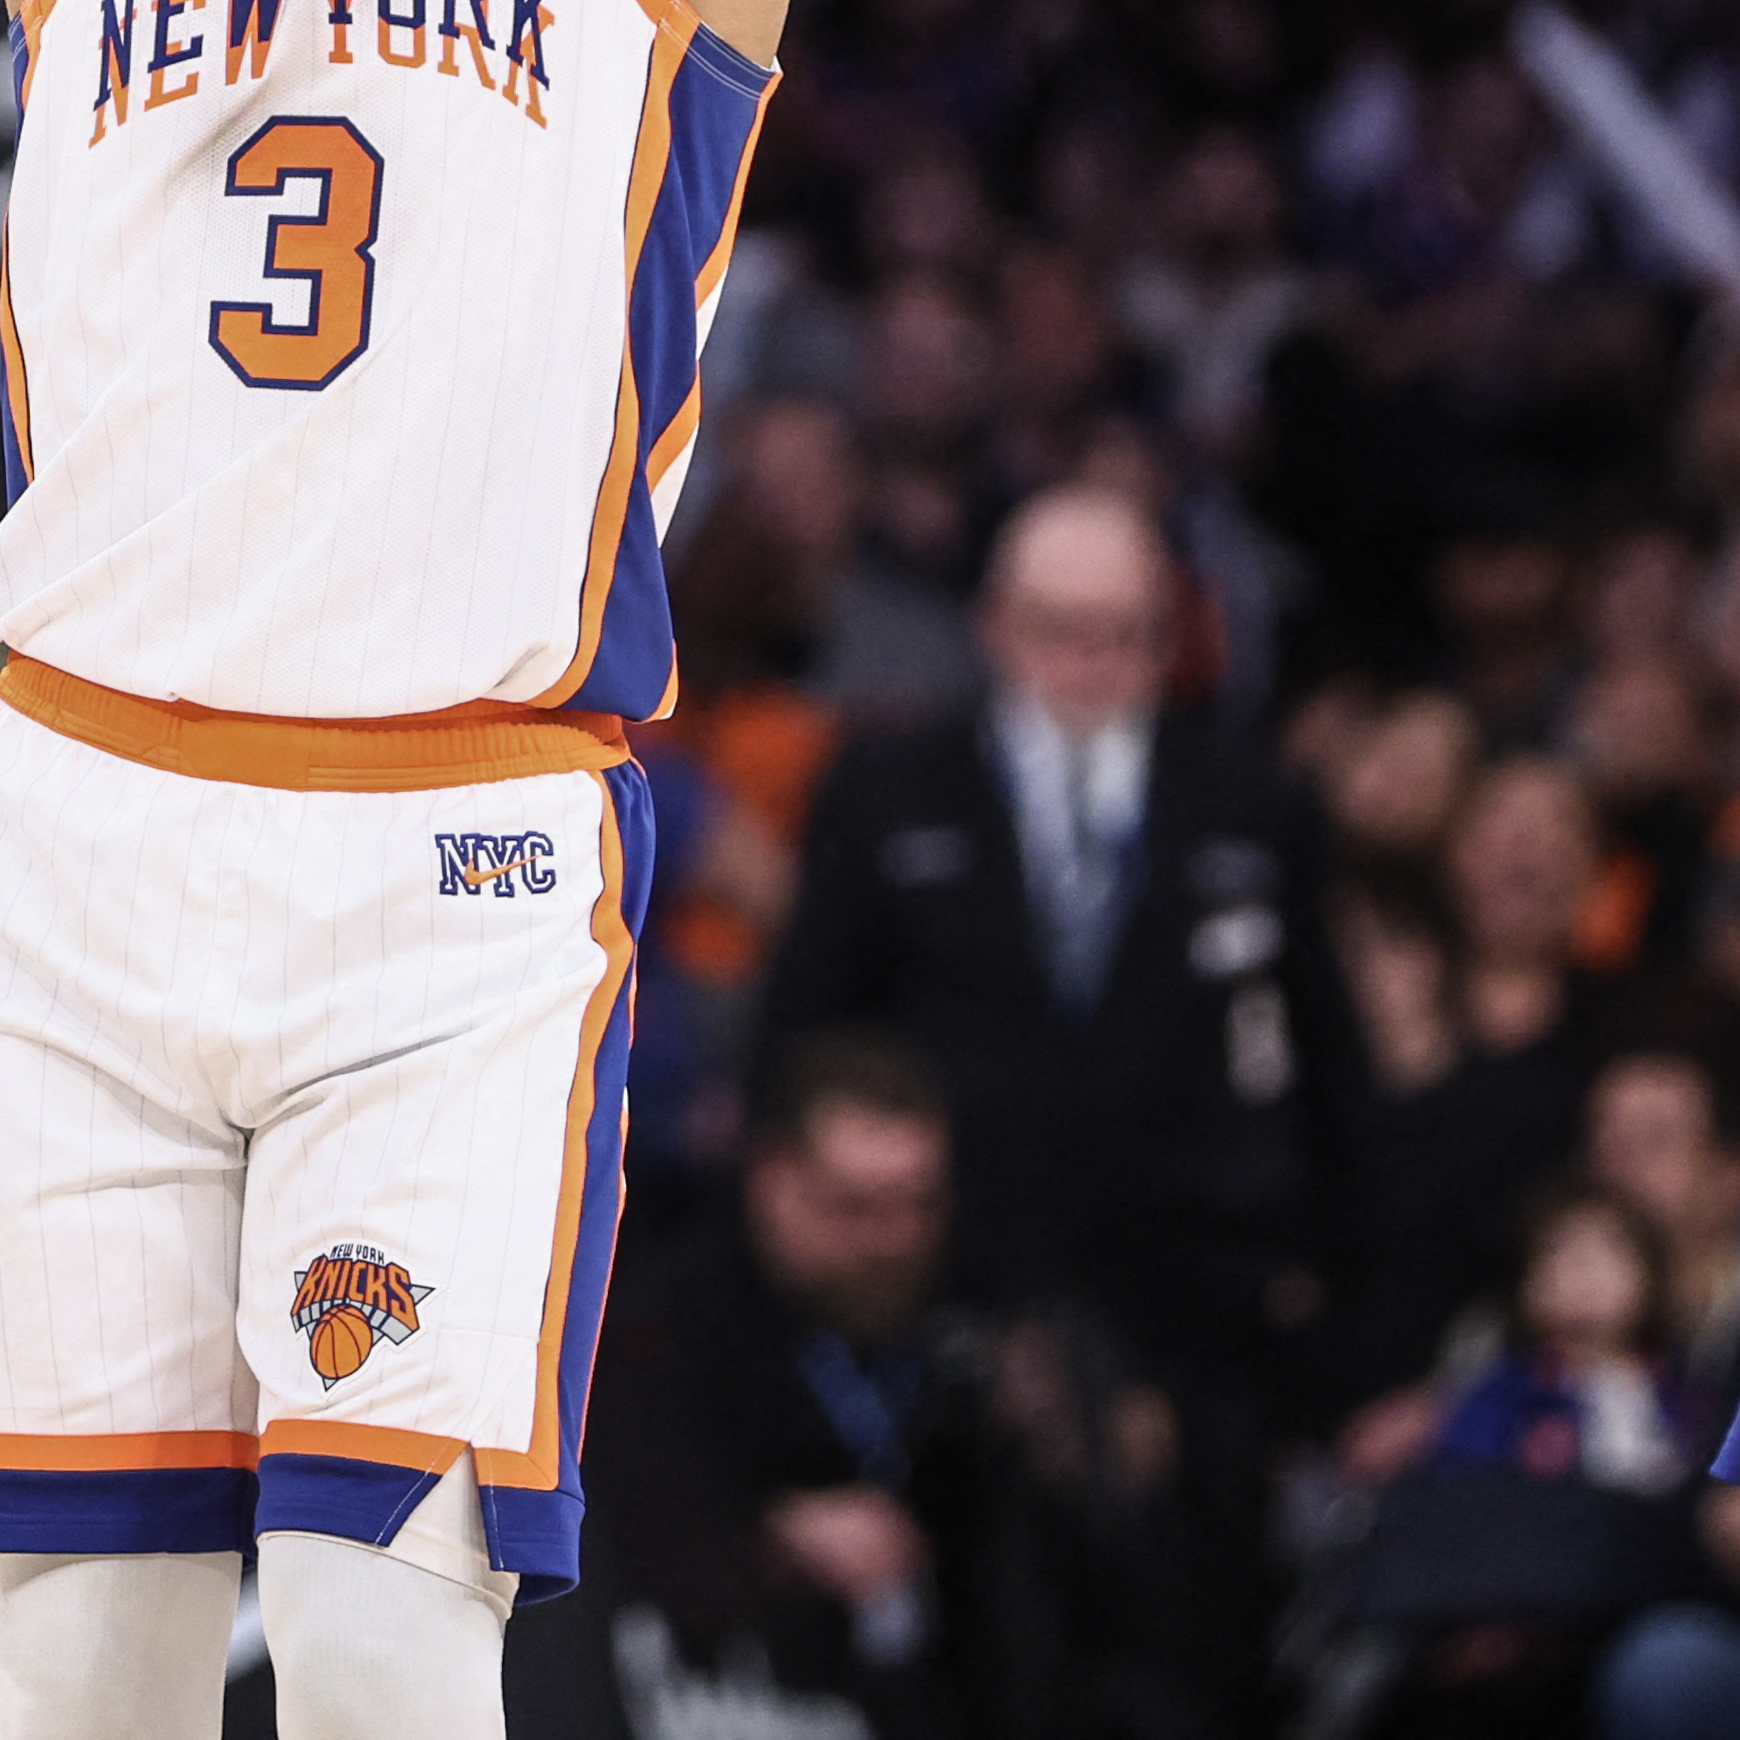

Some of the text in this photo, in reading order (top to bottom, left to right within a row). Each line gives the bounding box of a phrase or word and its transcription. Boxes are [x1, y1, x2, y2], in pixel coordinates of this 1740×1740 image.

[208, 115, 384, 392] 3
[434, 830, 557, 898] NYC
[329, 1242, 386, 1265] NEW YORK
[290, 1253, 421, 1334] KNICKS
